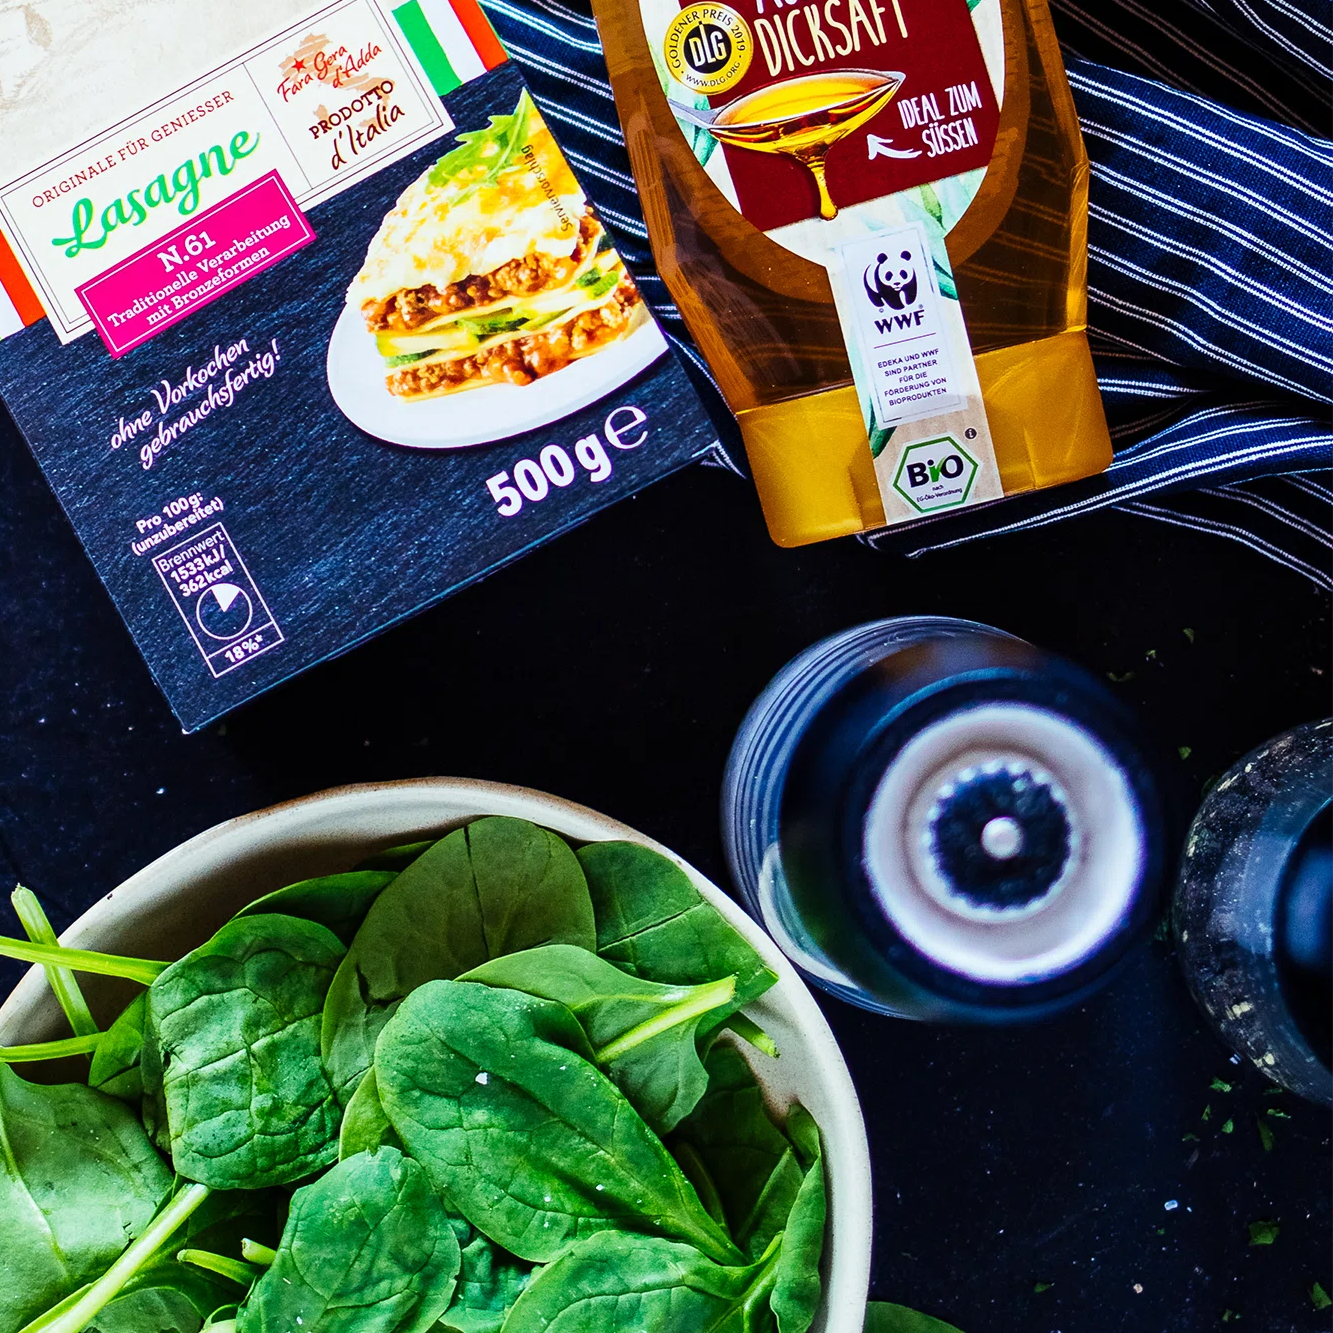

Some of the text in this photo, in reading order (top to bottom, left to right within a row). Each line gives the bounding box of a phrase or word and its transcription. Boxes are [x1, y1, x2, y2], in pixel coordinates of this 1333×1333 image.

[668, 8, 746, 69] GOLDENER PREIS 2019
[688, 21, 727, 68] DLG
[277, 45, 348, 103] Fara Gera
[332, 42, 382, 89] d'Adda
[685, 61, 741, 87] WWW.DLG.ORG
[308, 80, 394, 140] PRODOTTO
[897, 80, 982, 130] IDEAL ZUM
[32, 90, 234, 208] ORIGINALE FÜR GENIESSER
[331, 103, 406, 171] d'Italia
[921, 117, 978, 158] SÜSSEN
[51, 130, 261, 259] Lasagne
[520, 144, 574, 233] Serviervorschlag
[107, 215, 291, 328] Traditionelle Verarbeitung
[156, 231, 217, 273] N.61
[146, 247, 271, 326] mit Bronzeformen
[874, 309, 925, 335] WWF
[877, 348, 939, 369] EDEKA UND WWF
[884, 359, 938, 377] SIND PARTNER
[899, 371, 928, 383] FÜR DIE
[111, 339, 250, 449] ohne Vorkochen
[140, 338, 281, 470] gebrauchsfertig!
[884, 377, 947, 397] FÖRDERUNG VON
[889, 387, 947, 406] BIOPRODUKTEN
[131, 496, 225, 557] (unzubereitet)
[136, 515, 162, 534] Pro
[157, 530, 225, 573] Brennwert
